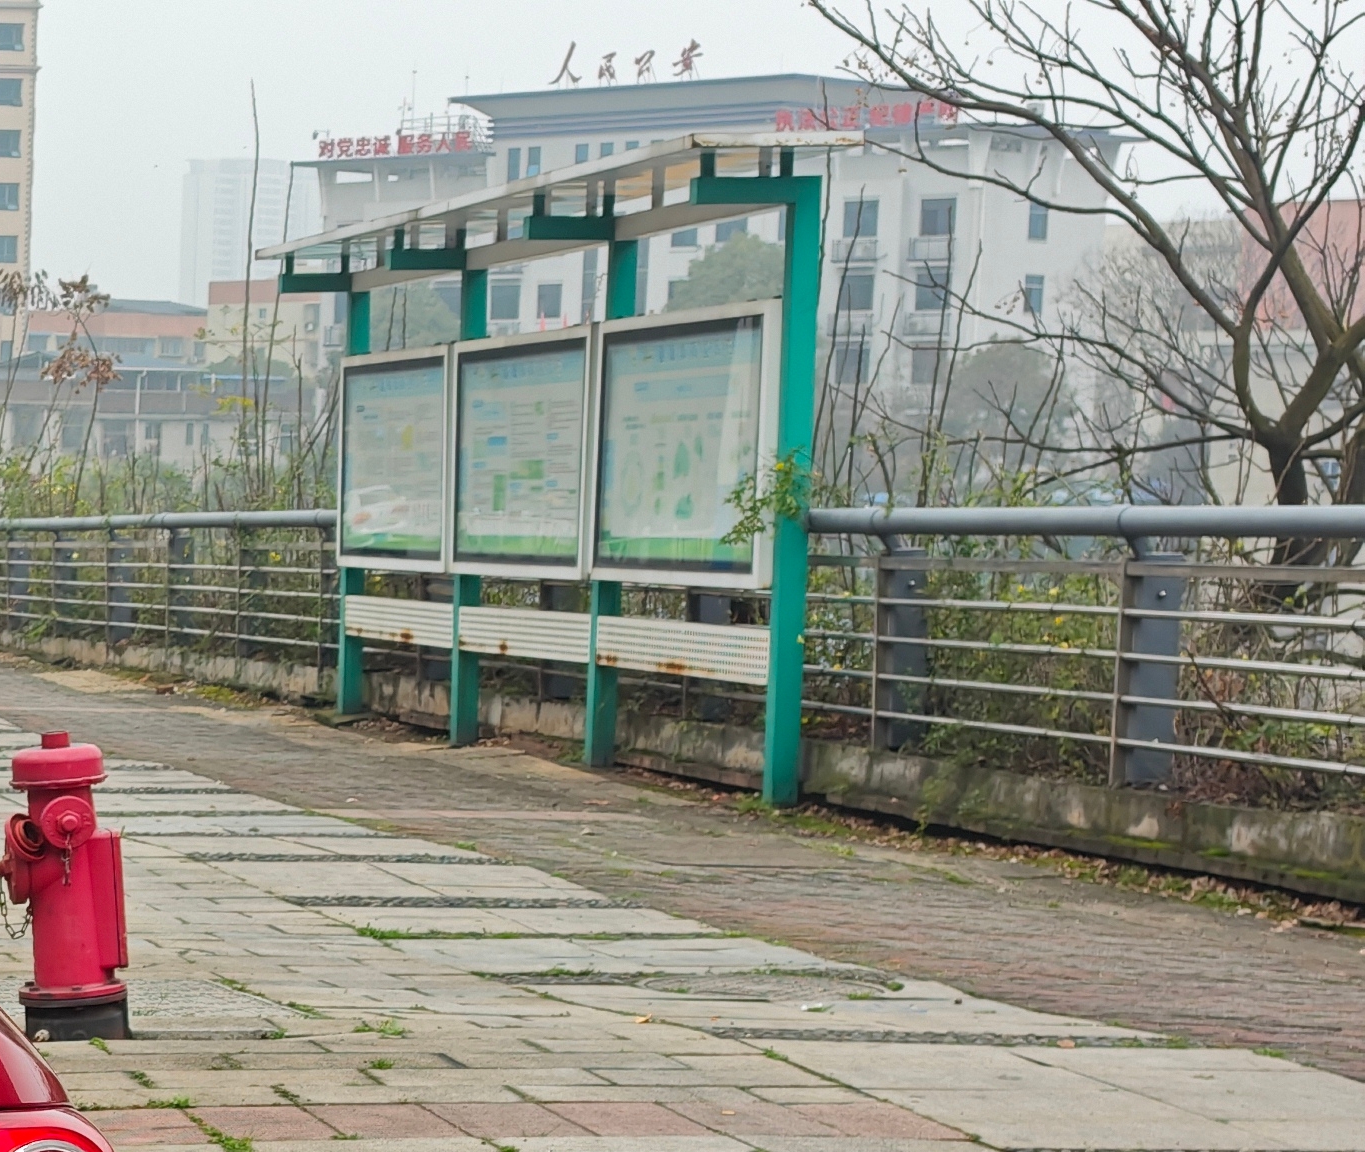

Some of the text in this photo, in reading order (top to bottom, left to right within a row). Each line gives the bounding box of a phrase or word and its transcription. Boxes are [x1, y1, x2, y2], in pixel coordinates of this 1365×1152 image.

[548, 38, 705, 85] 人民公安
[318, 131, 473, 159] 对党忠诚 服务人民
